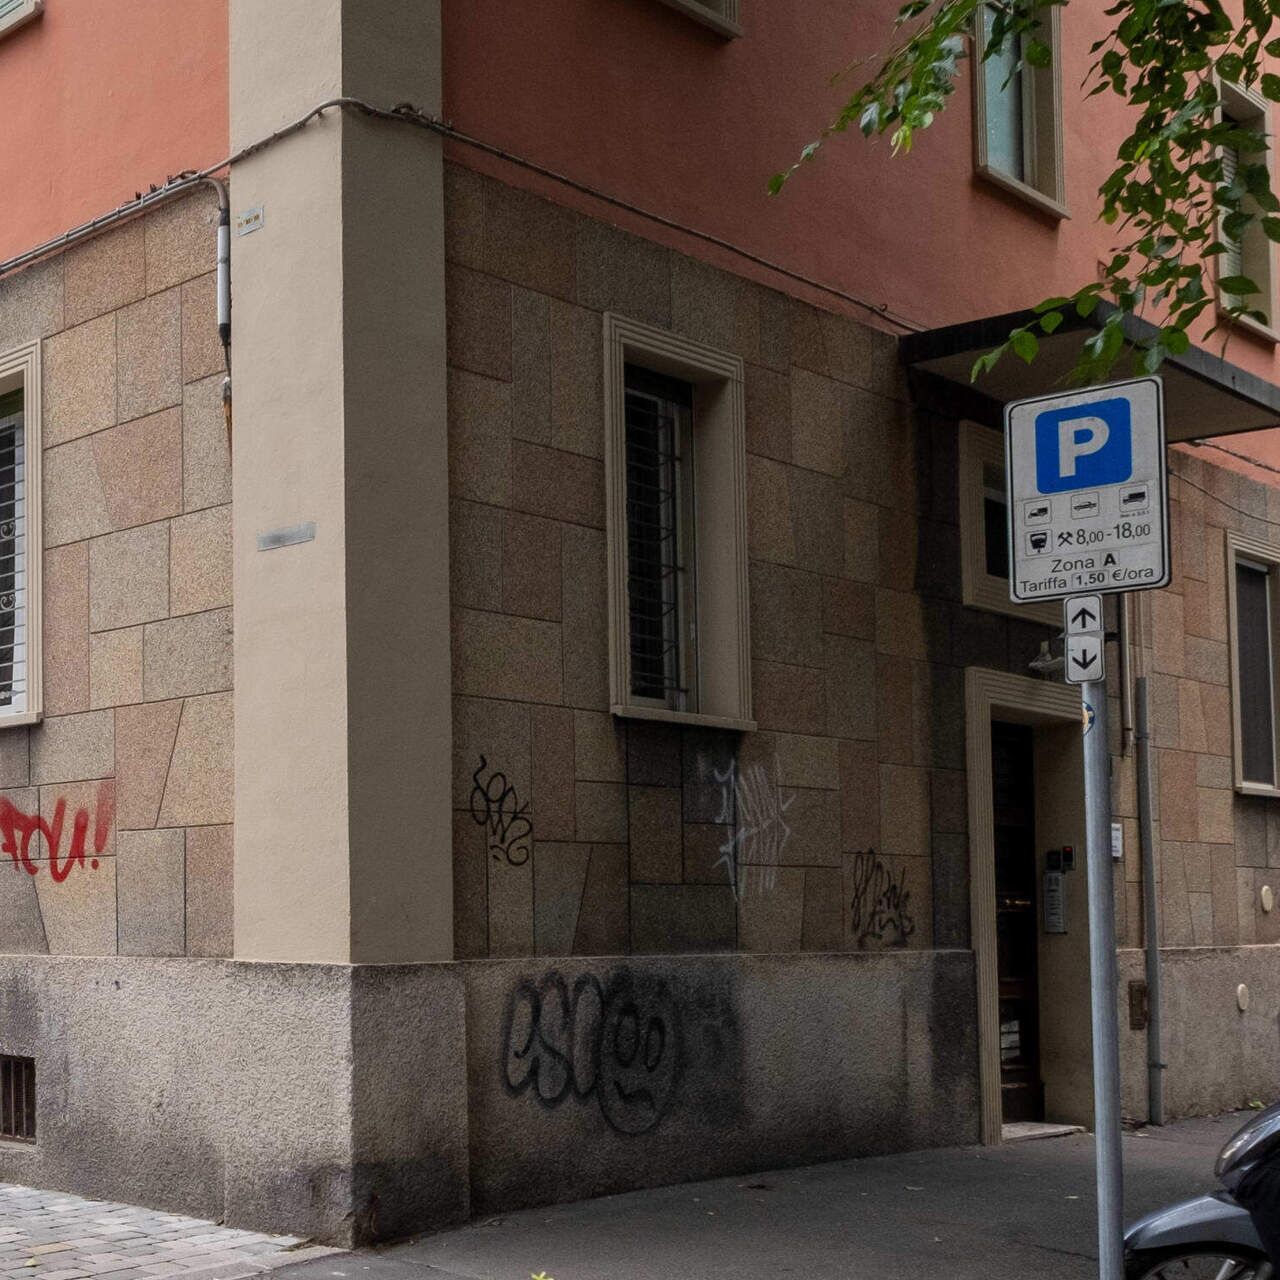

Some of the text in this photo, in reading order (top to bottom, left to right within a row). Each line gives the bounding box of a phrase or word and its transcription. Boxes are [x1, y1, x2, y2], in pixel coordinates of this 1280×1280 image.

[1058, 416, 1110, 479] P
[1051, 553, 1117, 573] Zona A
[1020, 577, 1067, 593] Tariffa
[1112, 568, 1154, 582] €/ora
